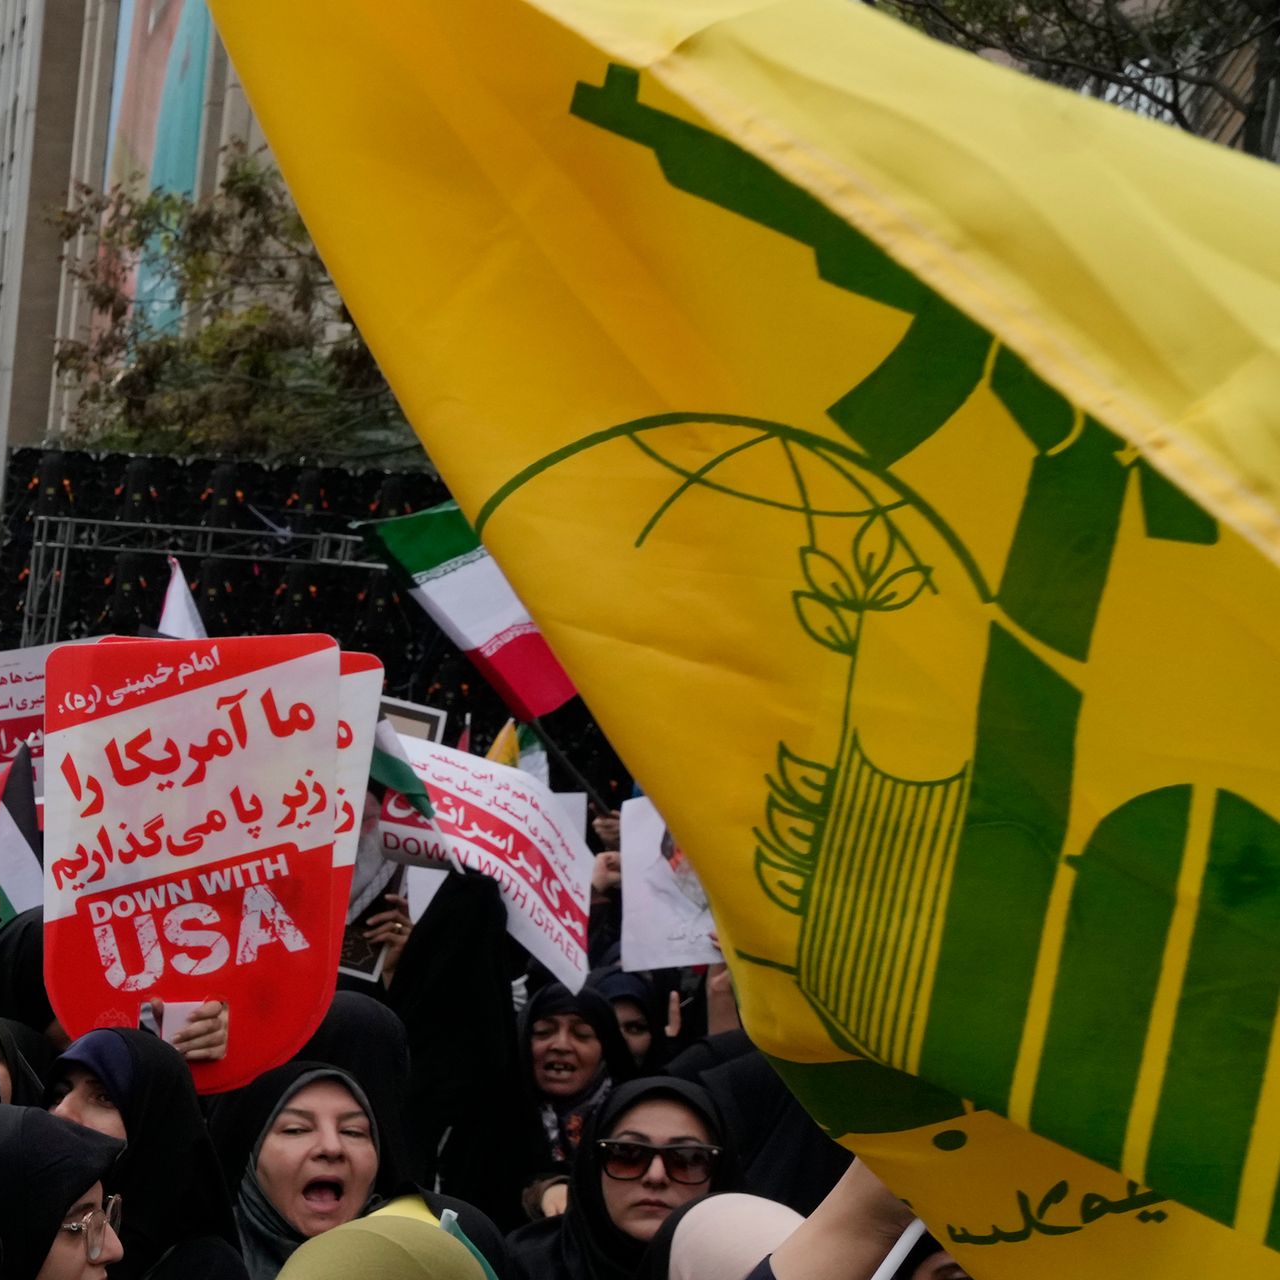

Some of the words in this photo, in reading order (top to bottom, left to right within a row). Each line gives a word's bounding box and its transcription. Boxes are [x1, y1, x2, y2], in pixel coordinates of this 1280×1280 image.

[107, 662, 173, 706] خمینی
[177, 646, 220, 685] امام
[104, 689, 248, 791] آمریکا
[260, 687, 315, 738] ما
[60, 753, 104, 818] را
[229, 785, 264, 839] پا
[277, 769, 327, 828] زیر
[89, 878, 193, 925] DOWN
[199, 853, 289, 896] WITH
[505, 852, 542, 884] بر
[93, 883, 310, 992] USA
[477, 855, 528, 910] WITH
[529, 903, 583, 972] ISRAEL
